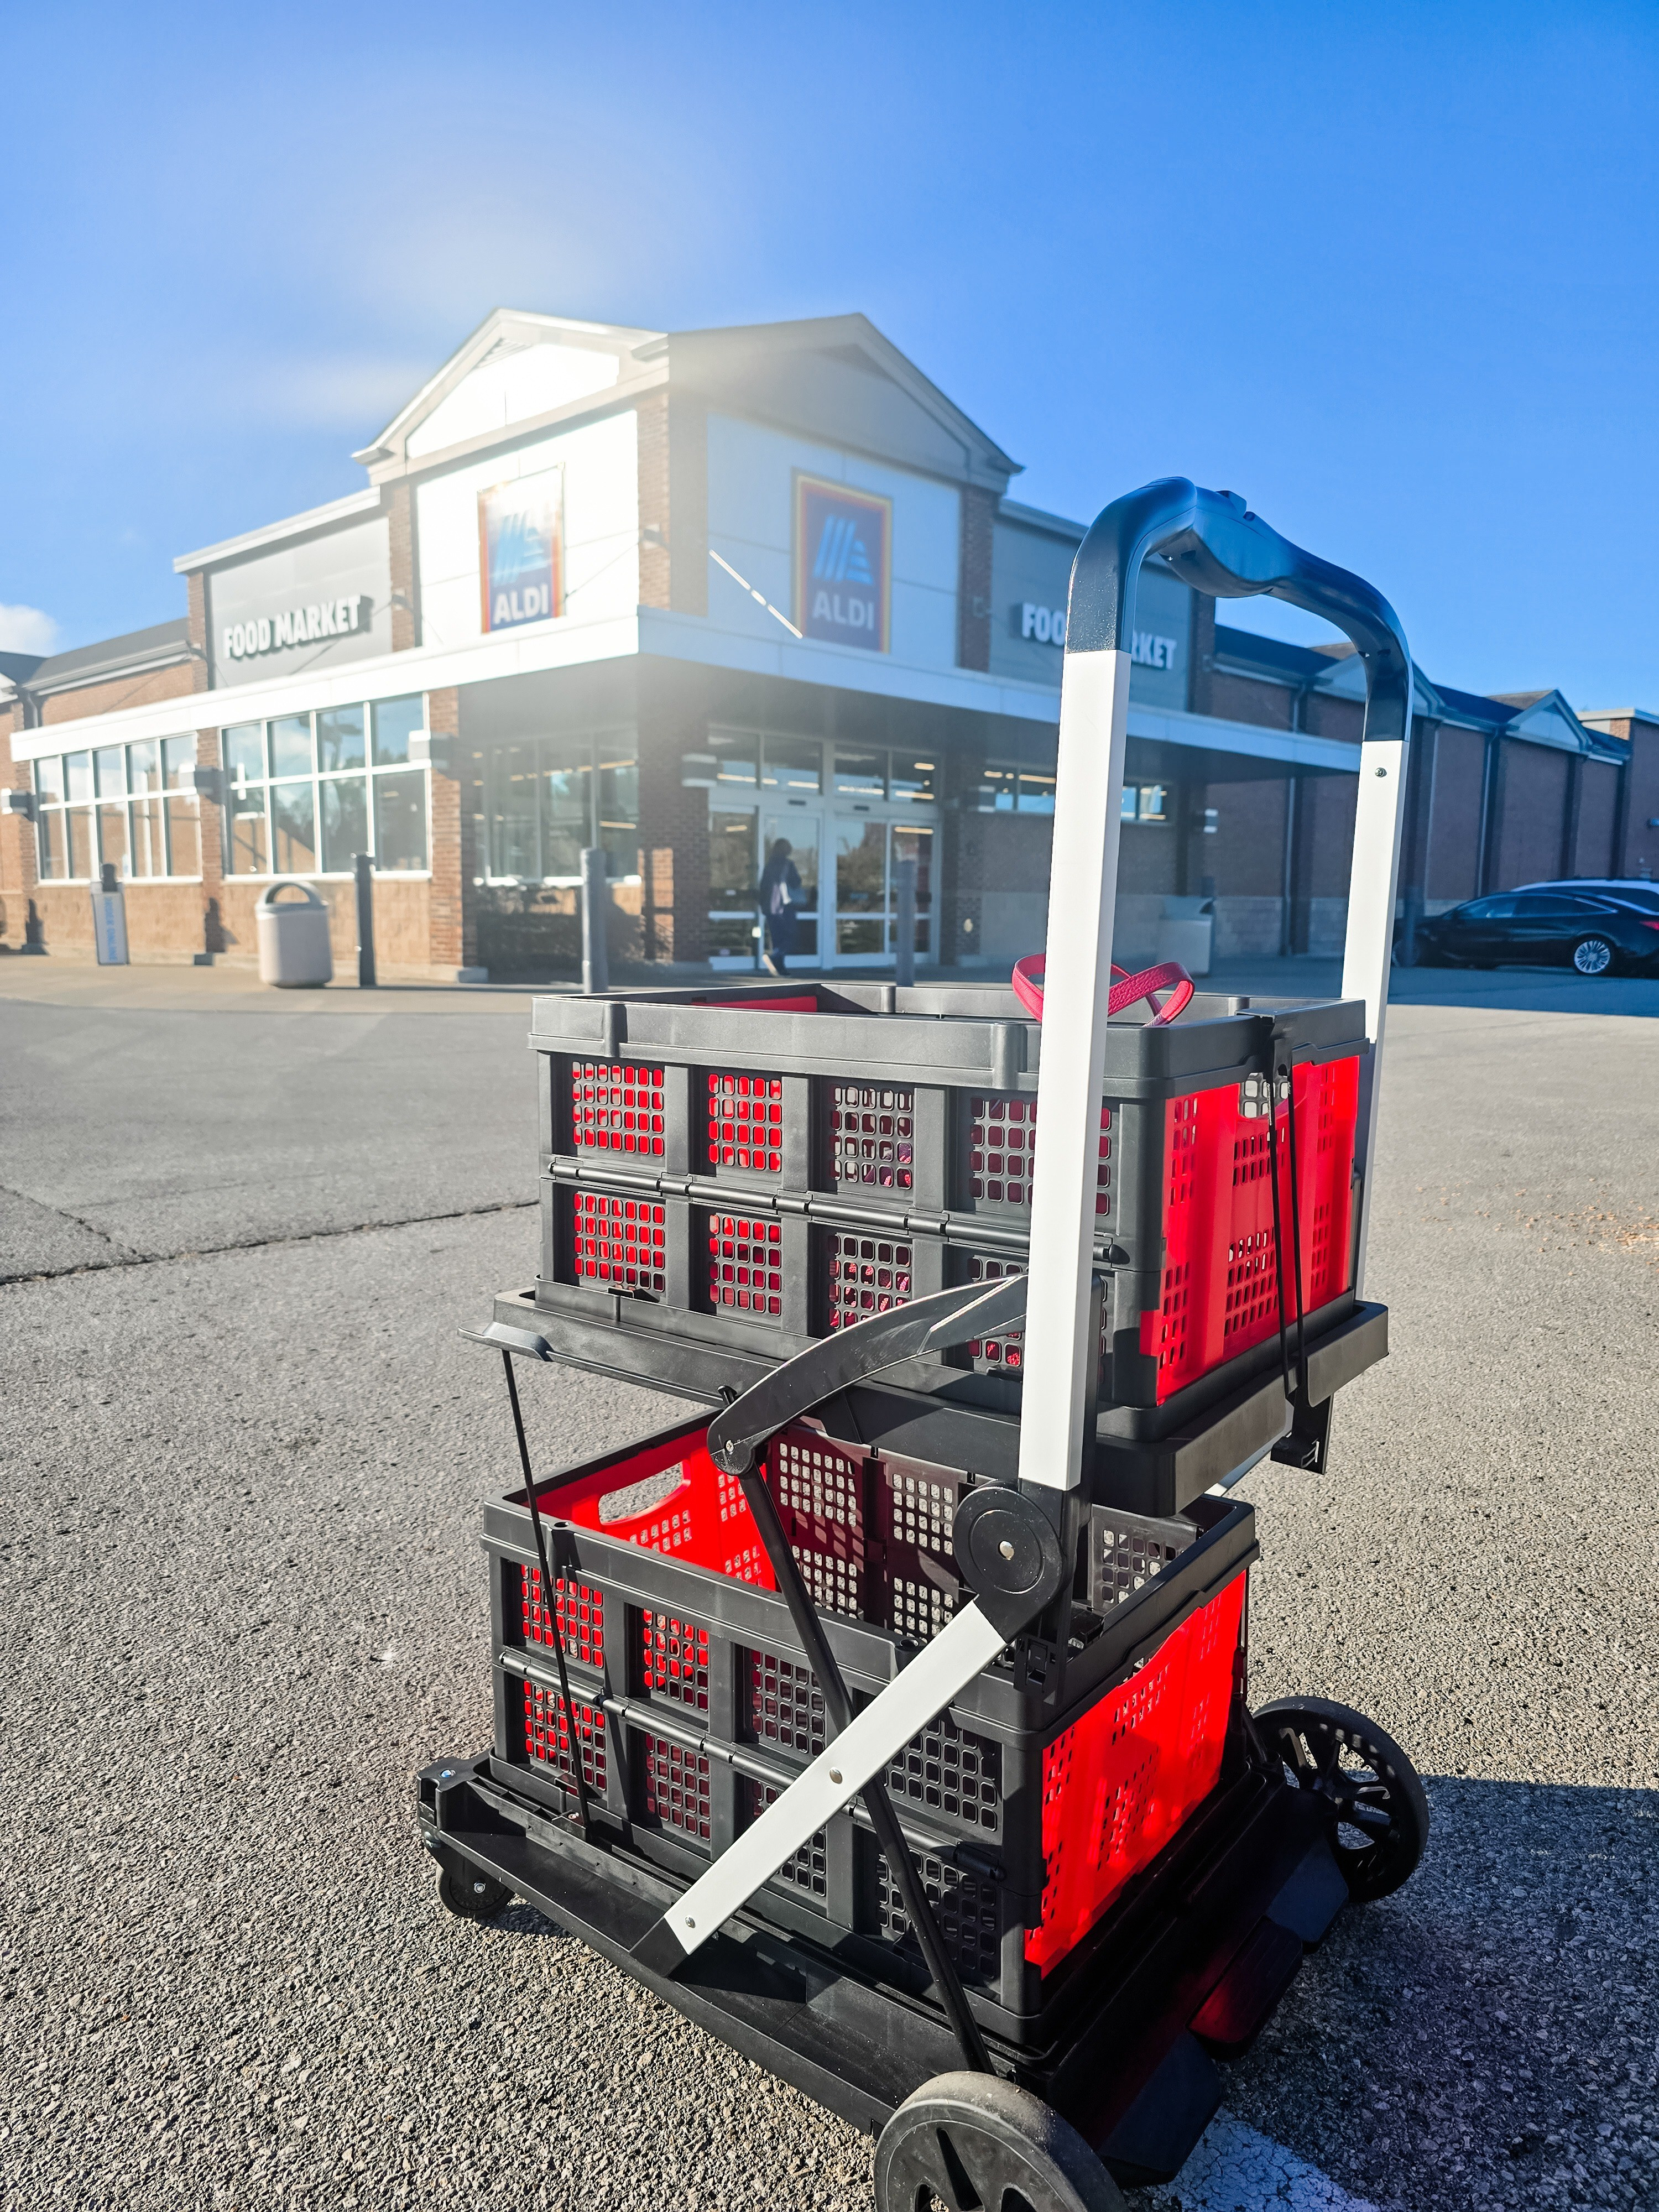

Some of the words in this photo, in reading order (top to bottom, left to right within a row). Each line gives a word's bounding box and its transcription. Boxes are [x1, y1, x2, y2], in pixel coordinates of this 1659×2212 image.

[493, 583, 549, 624] ALDI
[812, 590, 875, 630] ALDI
[223, 618, 271, 659] FOOD
[274, 594, 361, 648] MARKET
[1022, 604, 1067, 646] FOO
